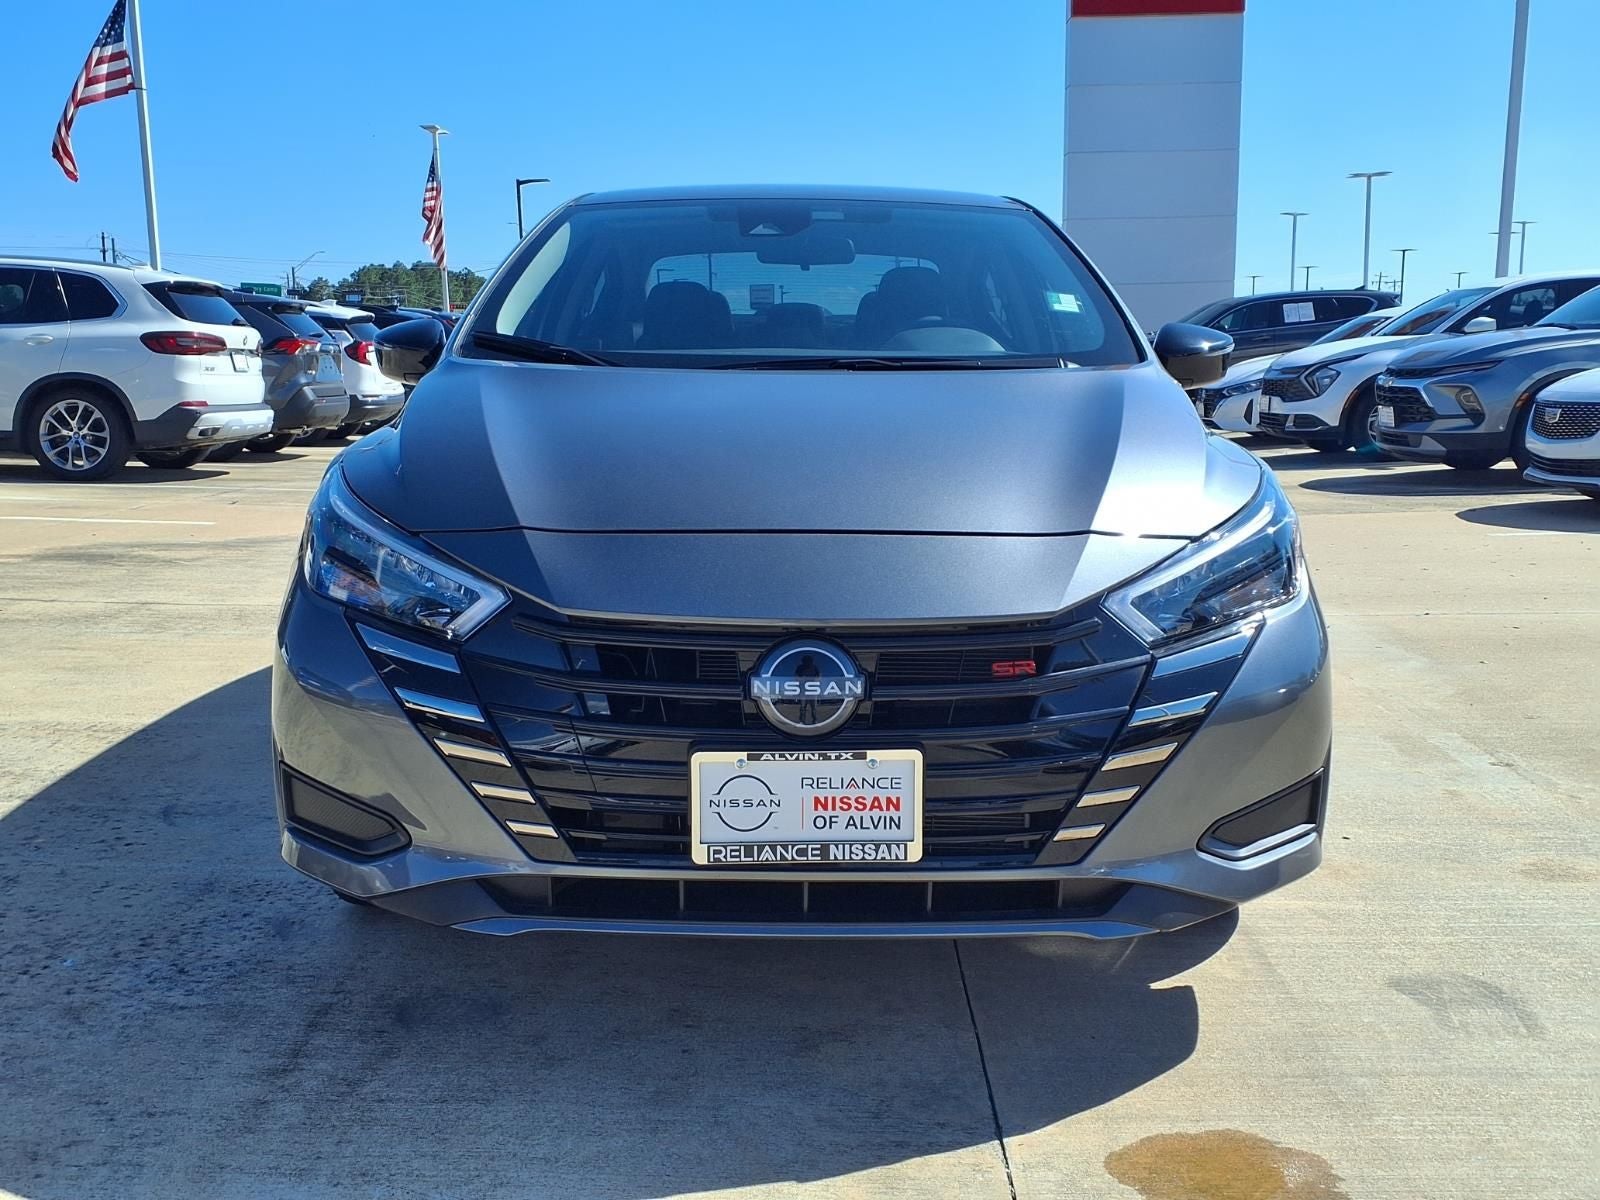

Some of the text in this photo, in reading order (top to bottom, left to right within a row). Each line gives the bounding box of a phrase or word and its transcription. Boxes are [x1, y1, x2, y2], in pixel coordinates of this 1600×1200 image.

[992, 661, 1036, 675] SR
[753, 680, 863, 695] NISSAN
[827, 752, 854, 760] TX
[801, 777, 902, 790] RELIANCE
[709, 799, 781, 808] NISSAN
[813, 796, 901, 812] NISSAN
[813, 815, 901, 830] OF ALVIN
[709, 843, 905, 862] RELIANCE NISSAN
